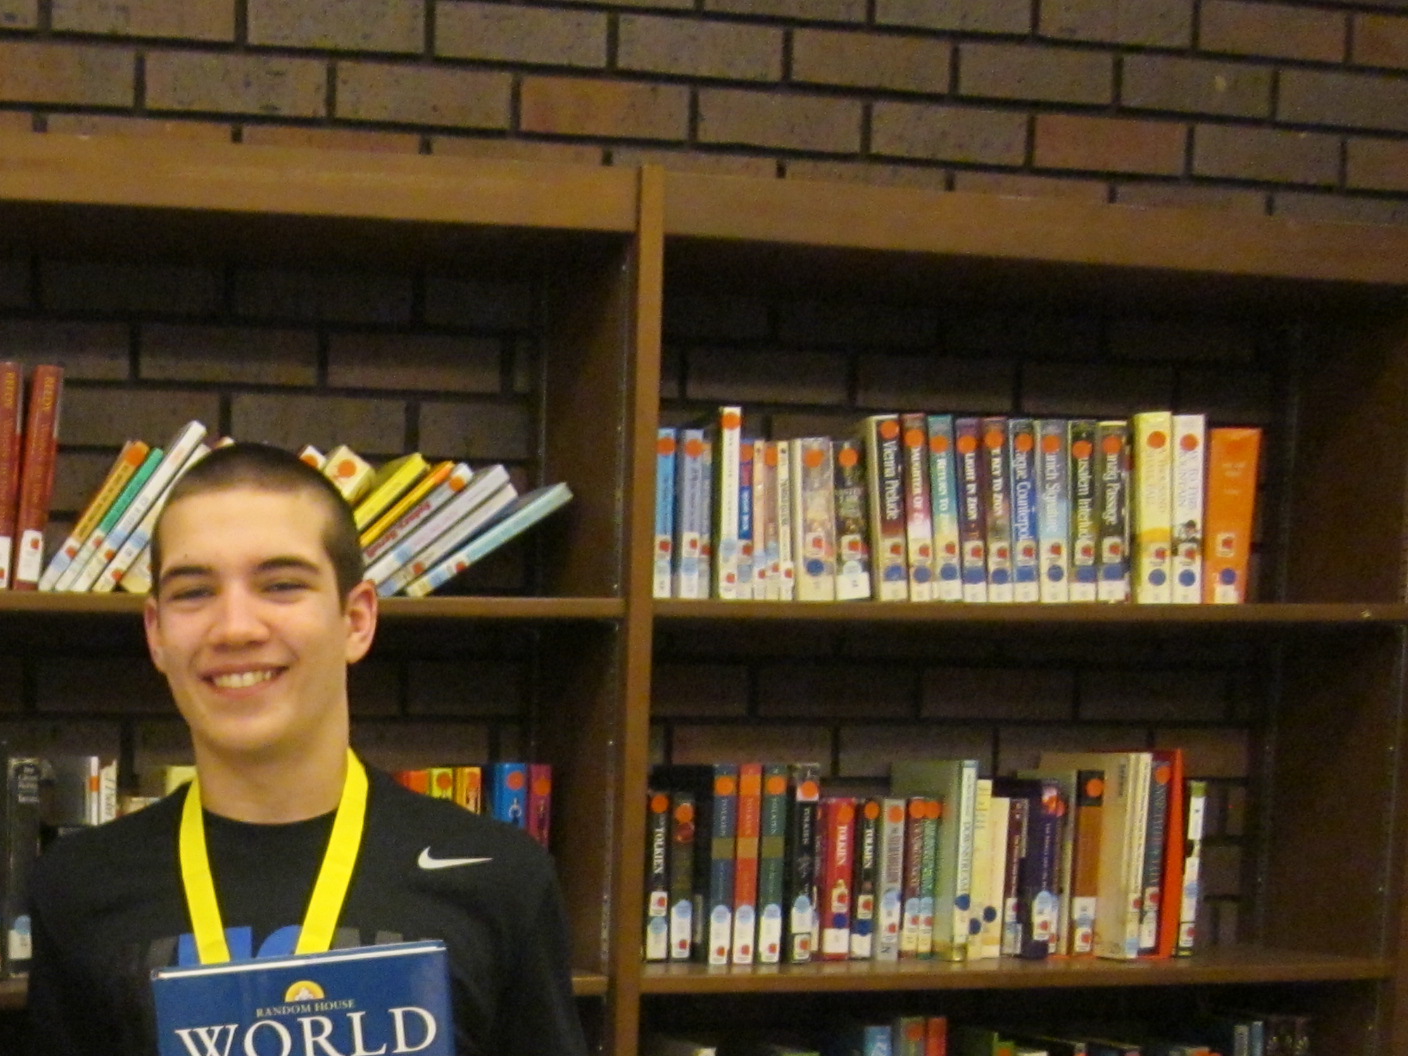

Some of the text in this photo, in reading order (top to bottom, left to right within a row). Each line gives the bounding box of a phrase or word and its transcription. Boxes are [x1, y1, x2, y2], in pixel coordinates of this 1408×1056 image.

[880, 441, 902, 520] Vienna Prelude
[1042, 451, 1062, 534] unich Signature
[1013, 481, 1035, 542] Counterpoi
[1077, 498, 1095, 542] Interlud
[1102, 482, 1122, 526] Passage
[653, 827, 667, 874] TOLKIEN
[836, 825, 850, 867] TOLKIEN
[863, 828, 876, 869] TOLKIEN
[255, 999, 356, 1018] RANDOM HOUSE
